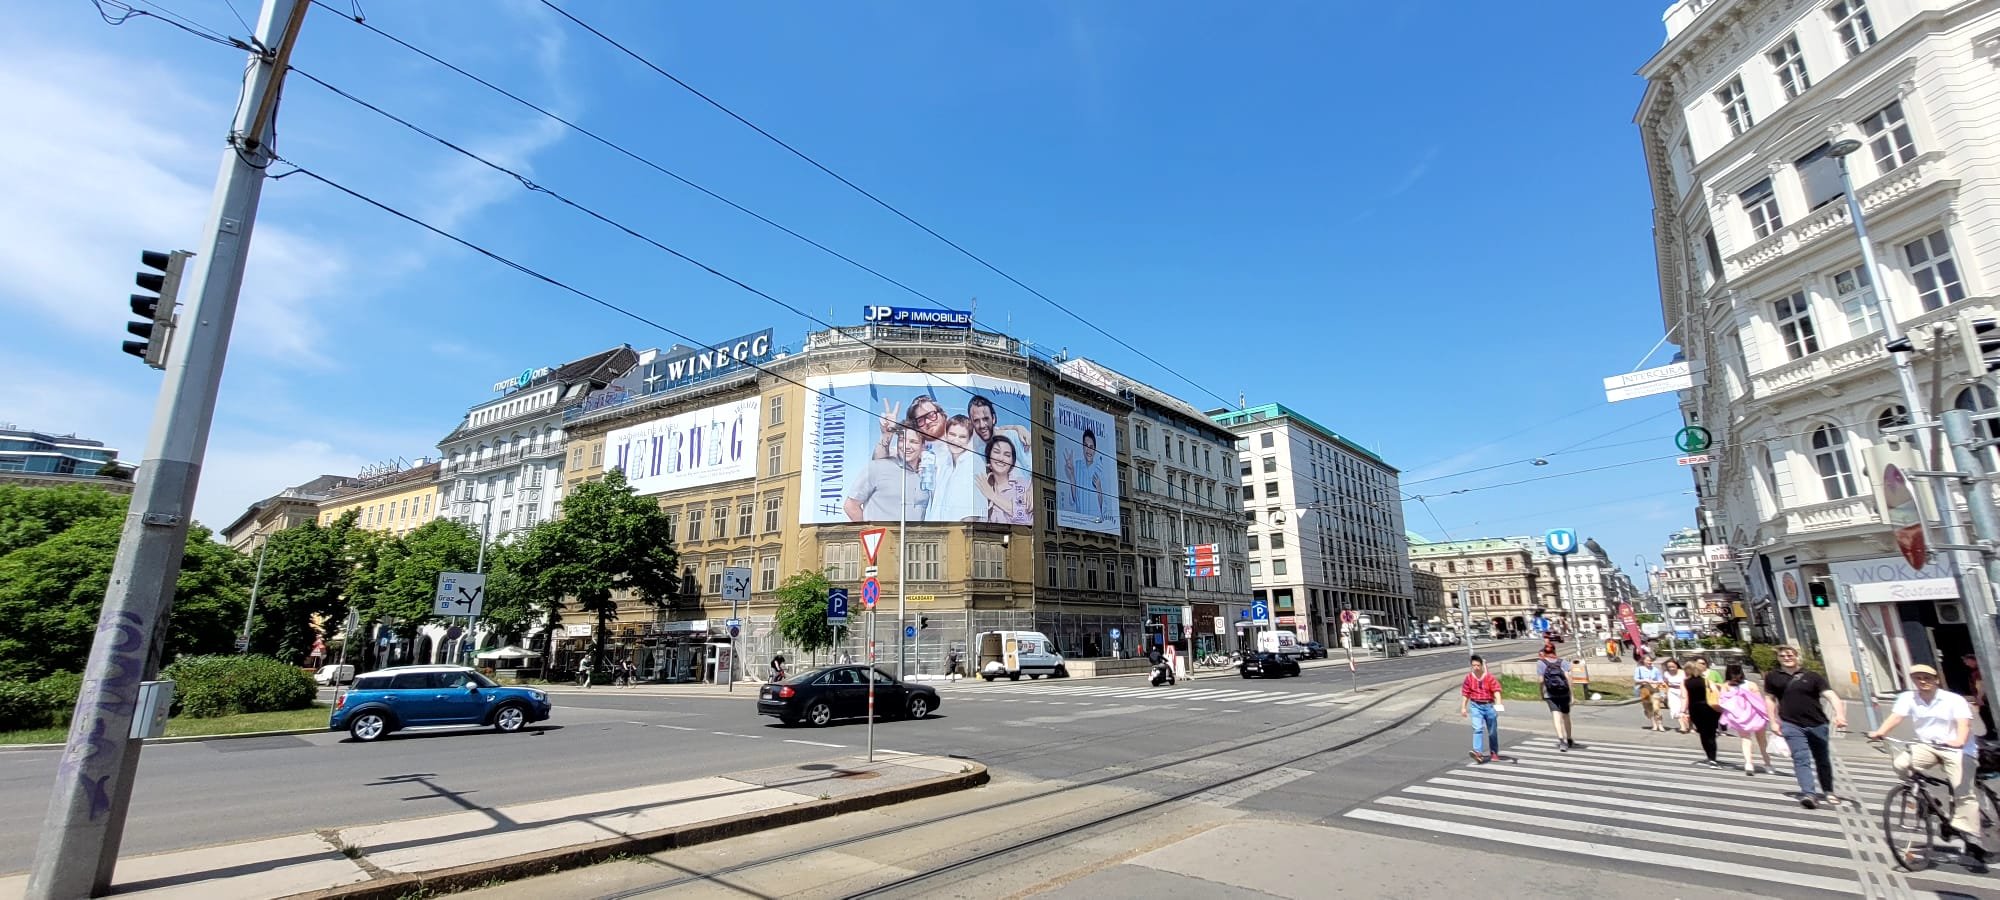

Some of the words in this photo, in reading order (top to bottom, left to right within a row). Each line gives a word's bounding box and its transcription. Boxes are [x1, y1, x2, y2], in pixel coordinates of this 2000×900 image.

[865, 306, 892, 320] JP
[894, 311, 909, 320] JP
[911, 312, 972, 323] IMMOBILIEN
[667, 334, 770, 382] WINEGG
[1621, 366, 1687, 385] INTERCURA
[819, 403, 847, 516] #JUNGBLEIBEN
[1679, 455, 1716, 465] SPAR
[1550, 533, 1570, 550] U
[1853, 563, 1910, 582] WOK
[438, 594, 455, 602] Graz
[833, 597, 843, 613] P
[1256, 606, 1264, 617] P
